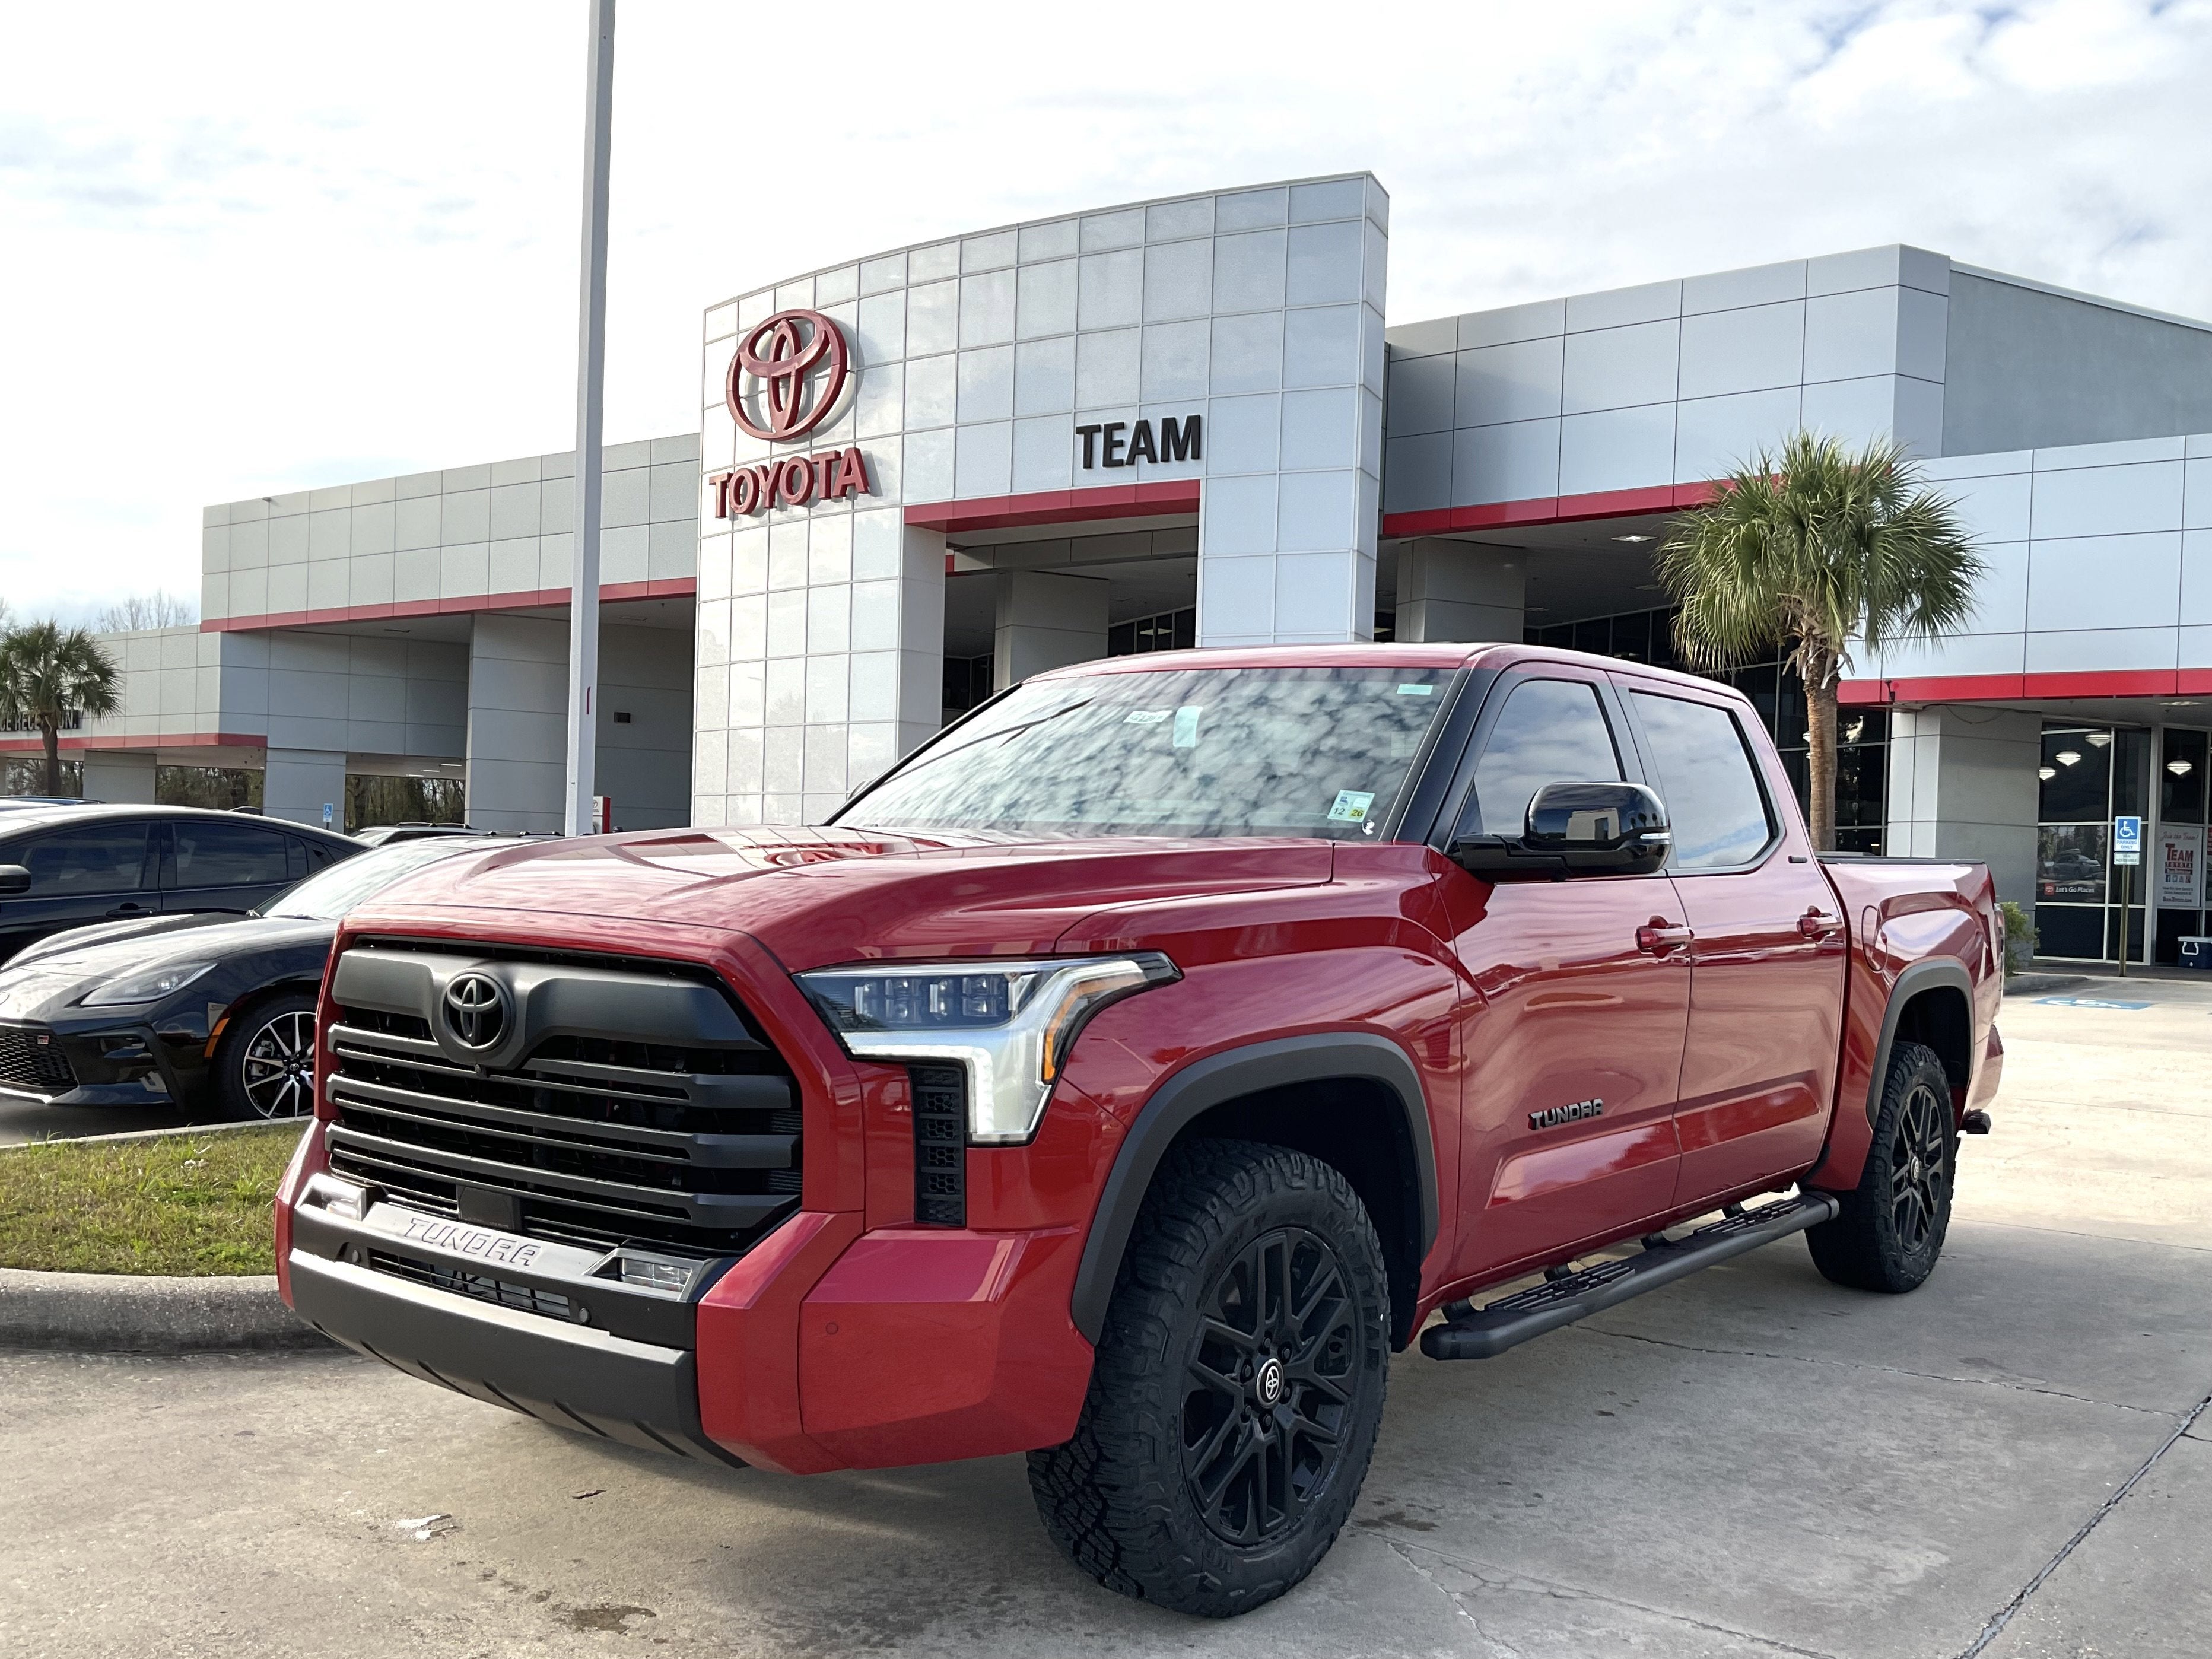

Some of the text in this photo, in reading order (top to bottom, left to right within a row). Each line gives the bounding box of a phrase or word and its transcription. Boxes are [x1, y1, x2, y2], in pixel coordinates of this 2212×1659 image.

[1075, 414, 1200, 469] TEAM
[709, 447, 869, 519] TOYOTA
[1529, 1098, 1603, 1130] TUNDRA
[404, 1218, 541, 1267] TUNDRA
